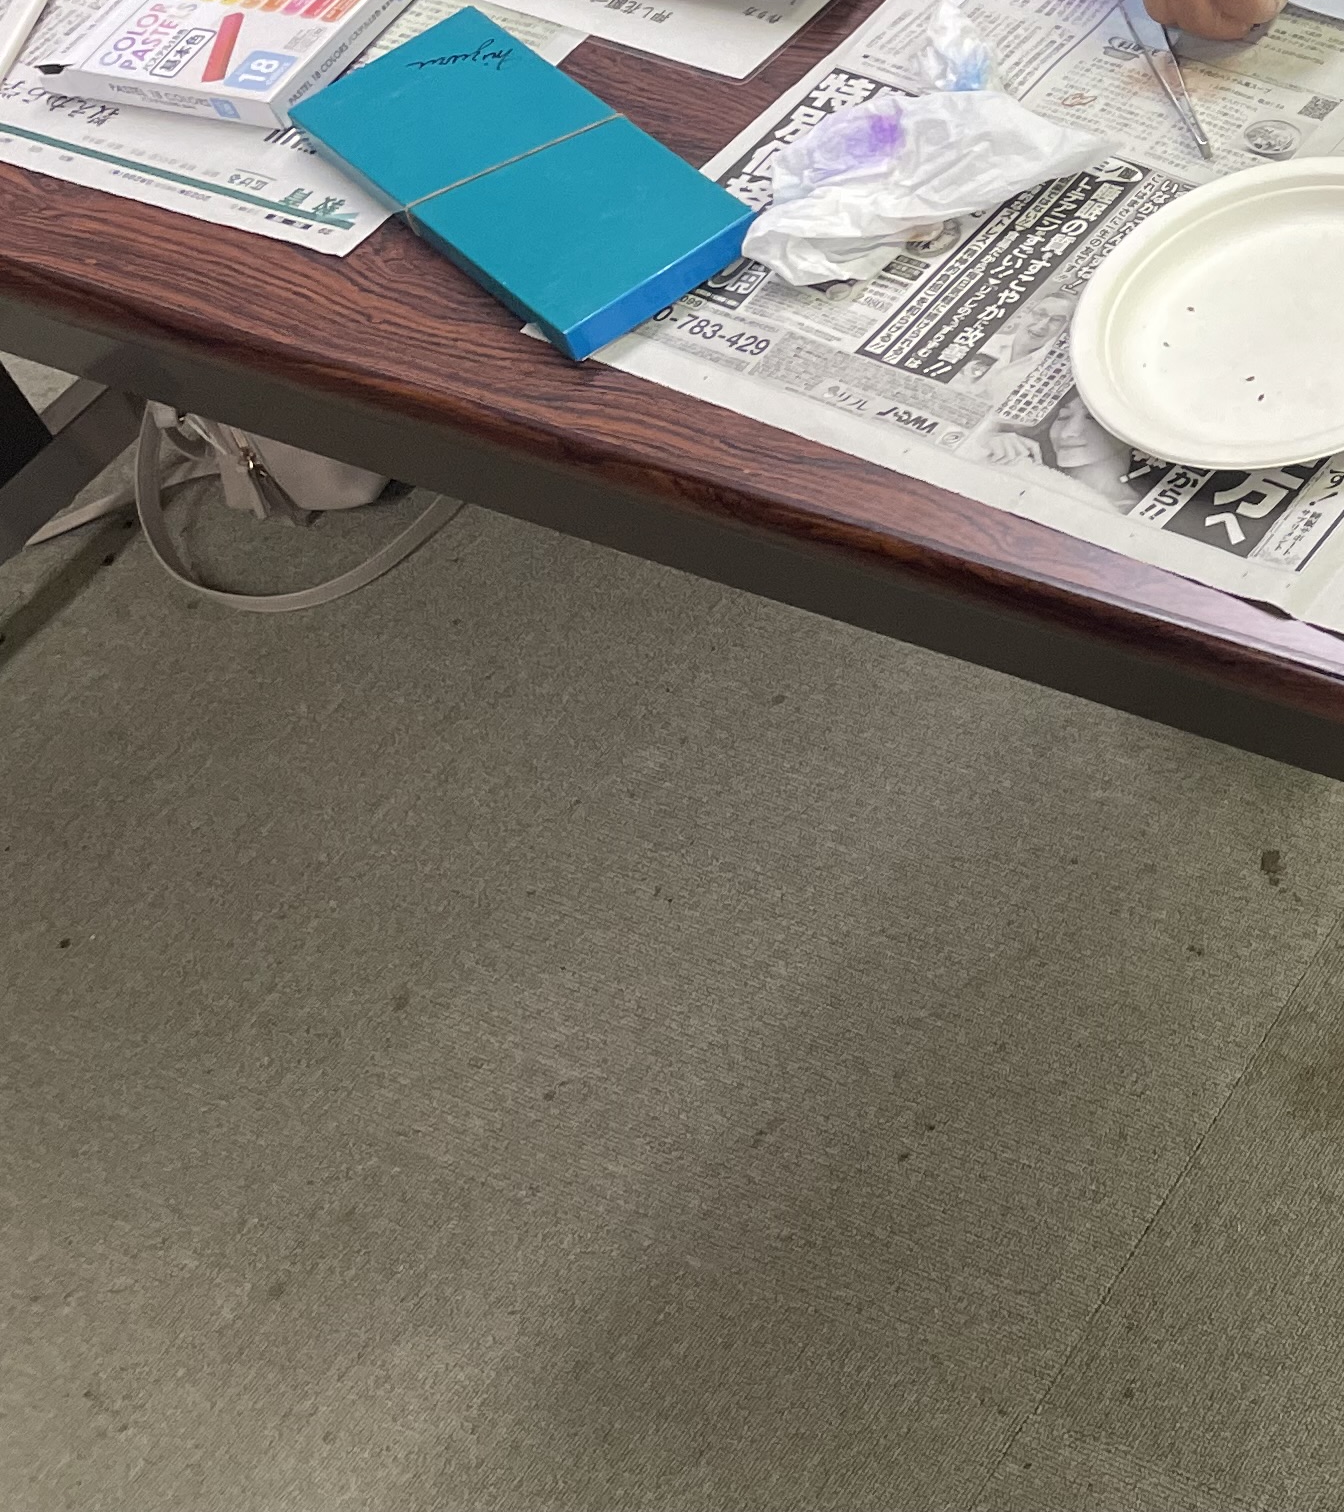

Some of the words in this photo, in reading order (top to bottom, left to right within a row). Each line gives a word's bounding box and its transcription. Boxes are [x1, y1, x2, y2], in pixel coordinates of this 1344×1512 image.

[101, 1, 169, 68] COLOR
[158, 30, 207, 74] 基本色
[237, 60, 278, 87] 18
[277, 188, 348, 218] 教育
